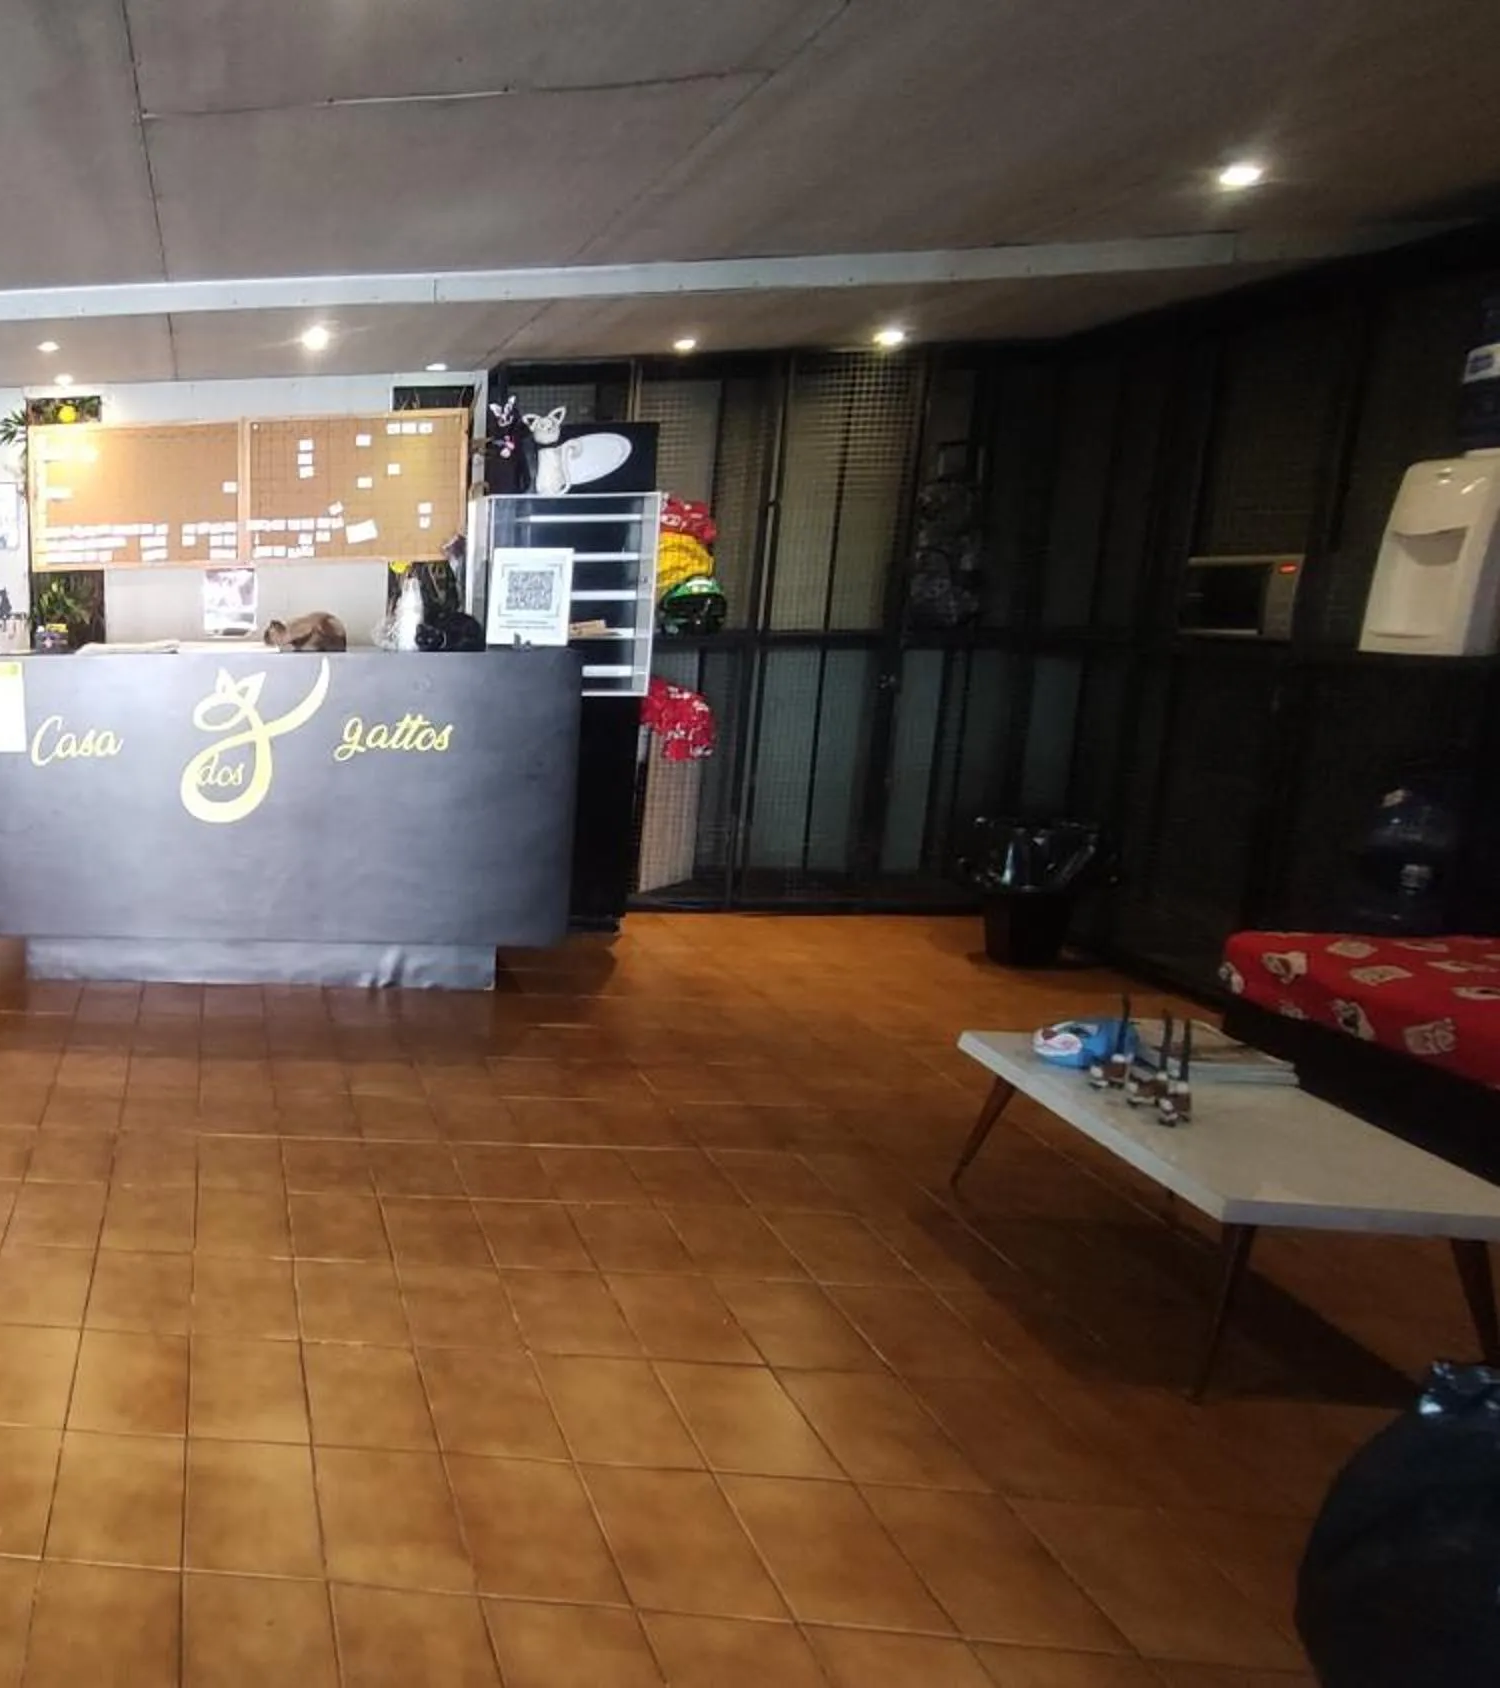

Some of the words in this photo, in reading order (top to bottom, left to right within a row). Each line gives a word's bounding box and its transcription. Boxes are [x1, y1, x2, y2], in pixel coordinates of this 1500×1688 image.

[31, 716, 124, 766] Casa
[198, 755, 244, 787] dos
[335, 714, 453, 762] gattos
